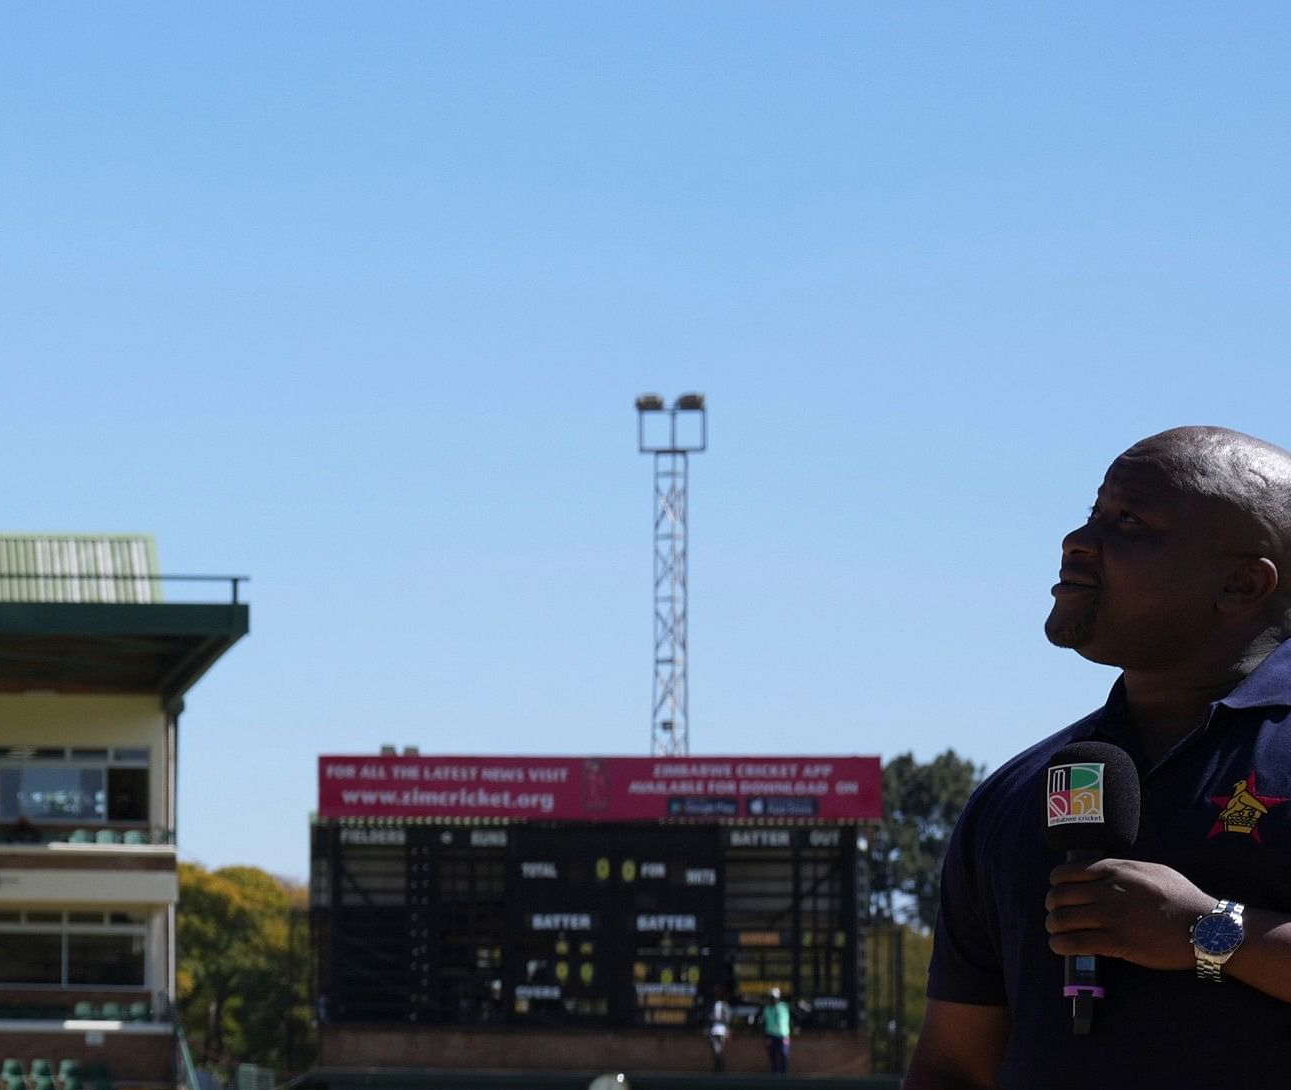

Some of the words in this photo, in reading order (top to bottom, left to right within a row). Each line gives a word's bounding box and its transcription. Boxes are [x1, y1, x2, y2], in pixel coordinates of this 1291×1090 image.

[326, 764, 355, 779] FOR
[360, 765, 386, 780] ALL
[392, 766, 420, 780] THE
[424, 766, 478, 781] LATEST
[482, 767, 523, 782] NEWS
[528, 767, 567, 782] VISIT
[653, 764, 732, 778] ZIMBABWE
[735, 764, 797, 777] CRICKET
[803, 764, 832, 777] APP
[628, 780, 704, 794] AVAILABLE
[708, 780, 736, 794] FOR
[740, 780, 828, 795] DOWNLOAD
[342, 787, 555, 812] www.zimcricket.org
[340, 828, 405, 845] FIELDERS
[730, 830, 790, 846] BATTER
[810, 830, 840, 846] OUT
[522, 862, 557, 879] TOTAL
[640, 862, 666, 878] FOR
[532, 913, 591, 930] BATTER
[636, 914, 696, 931] BATTER
